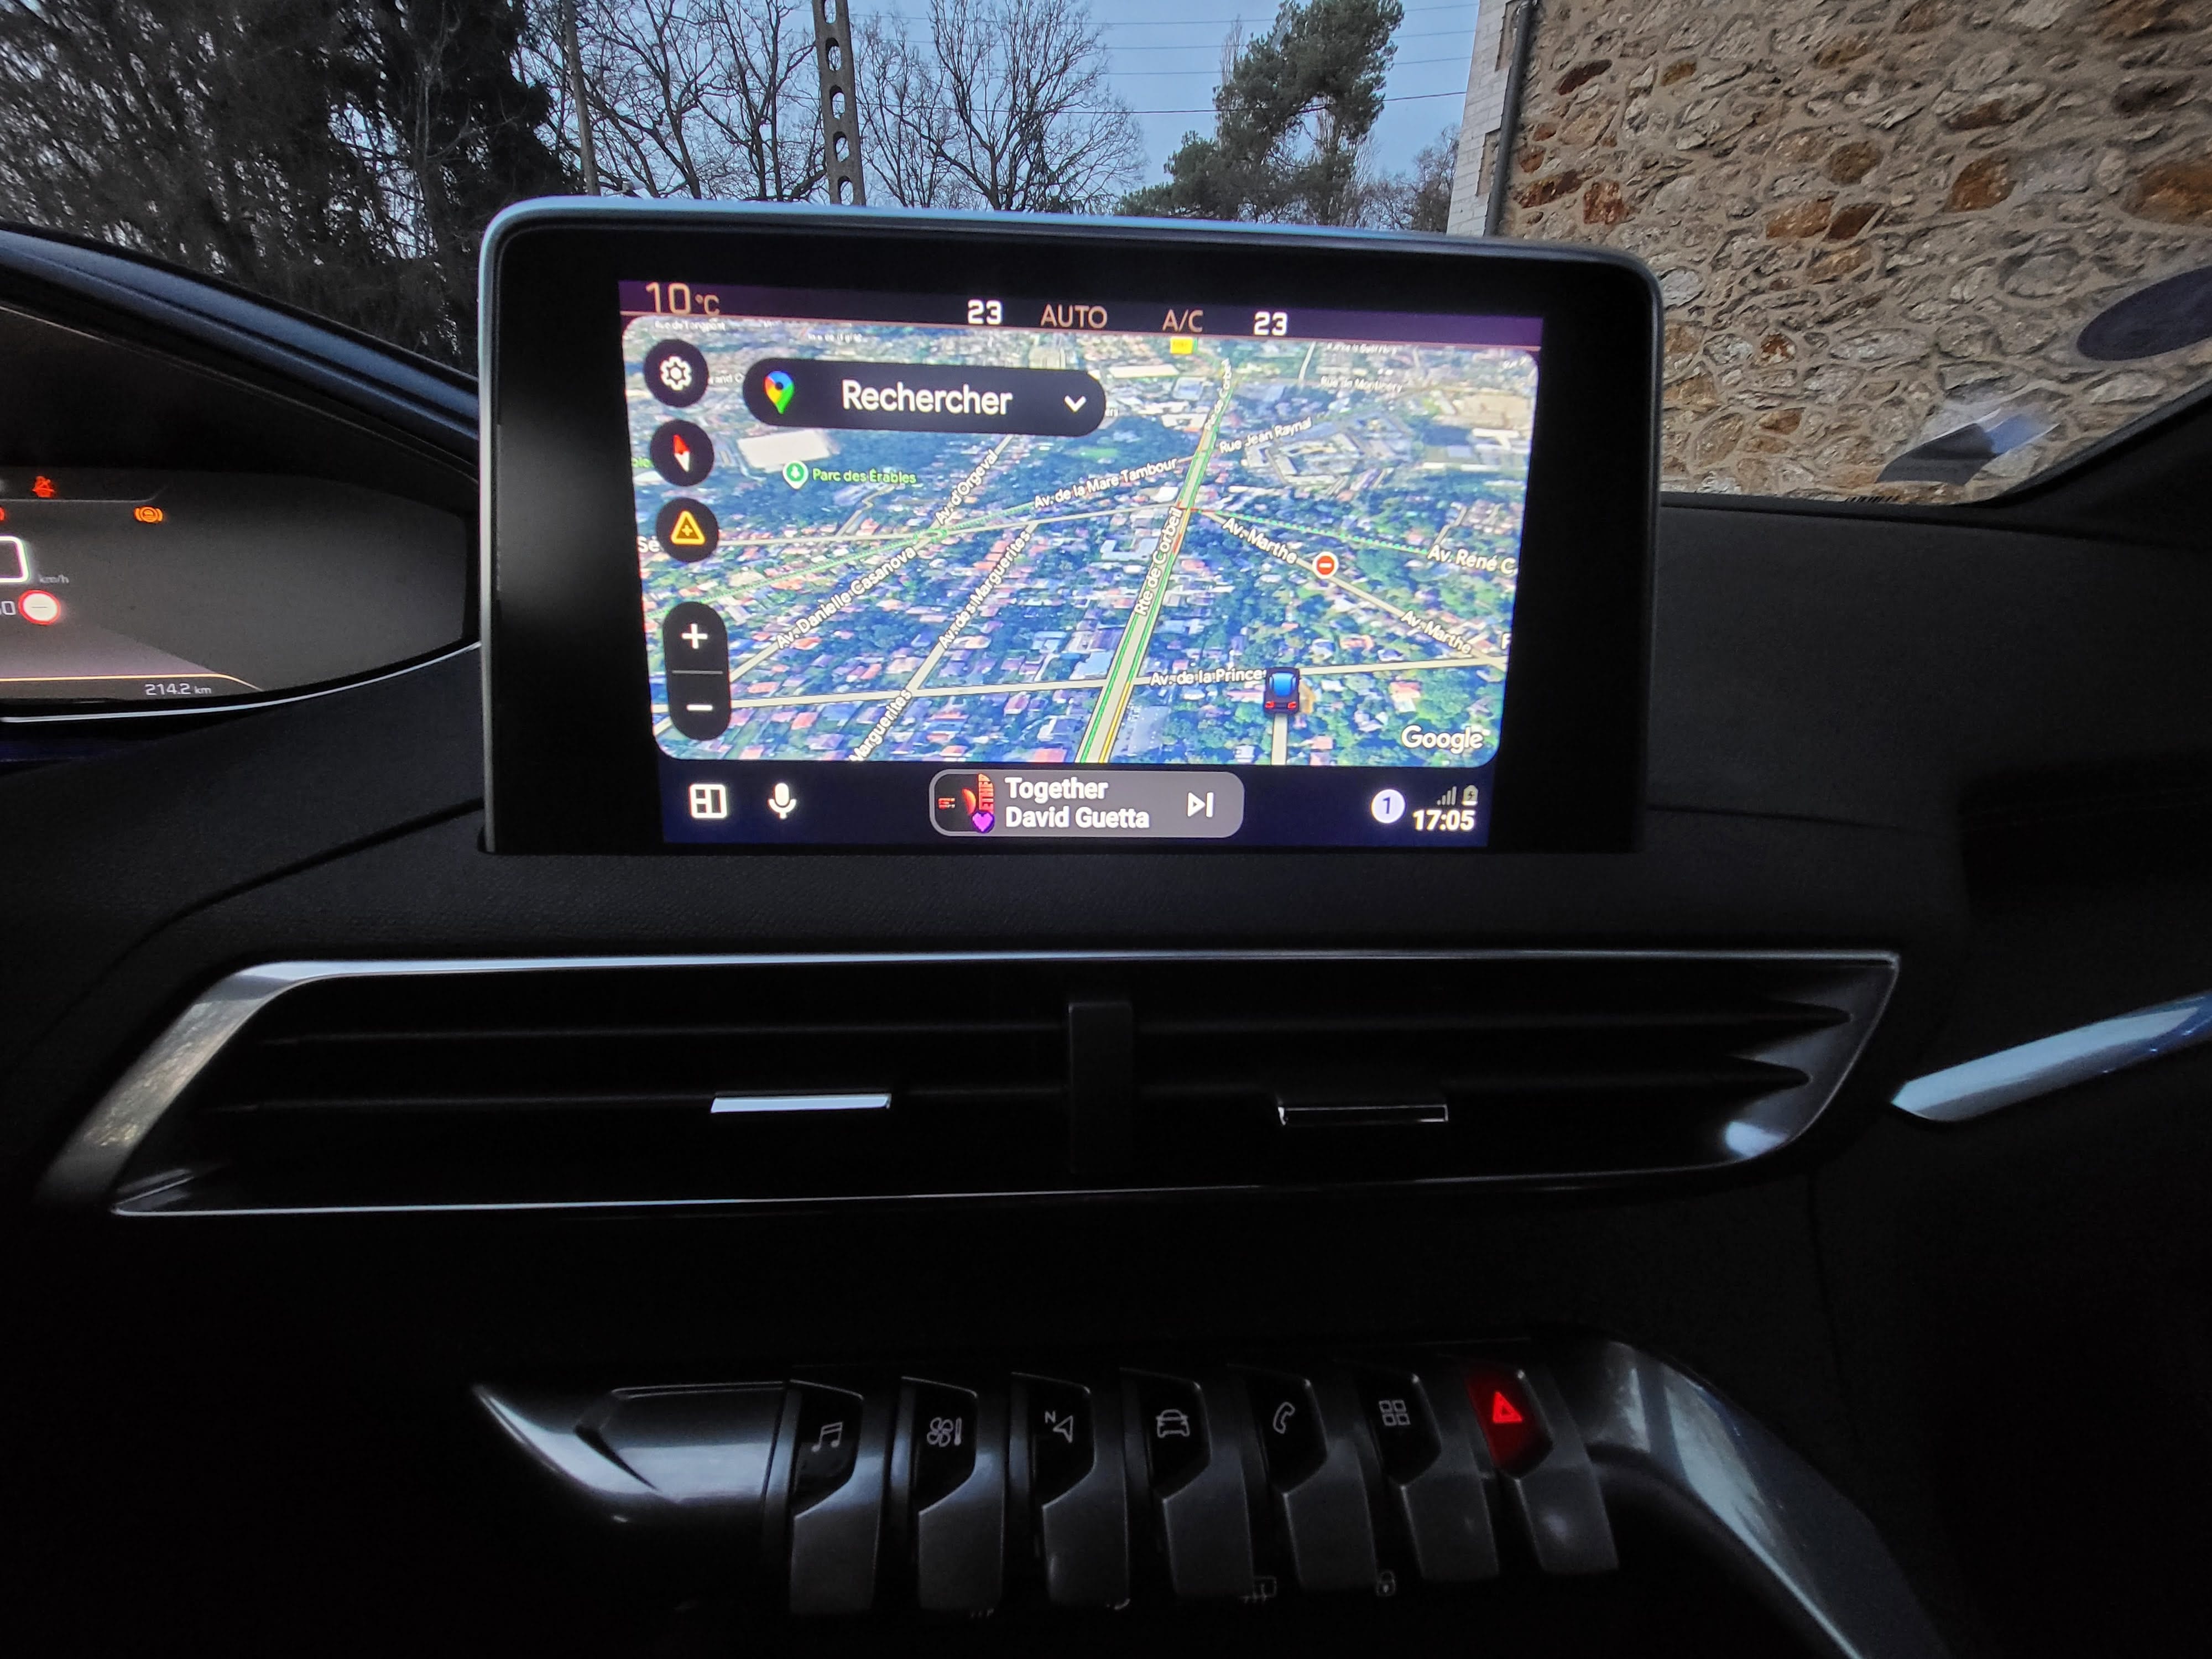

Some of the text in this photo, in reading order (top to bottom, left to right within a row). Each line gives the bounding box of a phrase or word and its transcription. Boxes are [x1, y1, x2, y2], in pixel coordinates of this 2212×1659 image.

[968, 299, 1002, 325] 23
[1041, 304, 1108, 328] AUTO
[1162, 309, 1203, 332] A/C
[1254, 311, 1287, 336] 23
[842, 379, 1013, 415] Rechercher
[1219, 416, 1312, 453] Rue Jean Raynal
[813, 468, 916, 484] Parc des Érables
[1035, 458, 1177, 508] Av. de la Mare Tambour
[936, 507, 953, 525] Av.
[1222, 518, 1297, 565] Av. Marthe
[1427, 545, 1452, 563] Av.
[1455, 549, 1498, 571] René
[776, 547, 917, 649] Av. Danielle Casanova
[939, 530, 1030, 649] Av. des Marguerites
[1134, 590, 1153, 615] Rte
[1146, 567, 1161, 588] de
[1401, 611, 1421, 629] Av.
[1424, 620, 1472, 654] Marthe
[145, 683, 212, 696] 214.2 km
[1150, 672, 1173, 686] Av.
[1177, 671, 1194, 685] de
[1198, 670, 1211, 683] la
[1401, 725, 1483, 754] Google
[1004, 776, 1109, 804] Together
[1005, 805, 1150, 828] David Guetta
[1383, 796, 1391, 815] 1
[1412, 810, 1476, 831] 17:05
